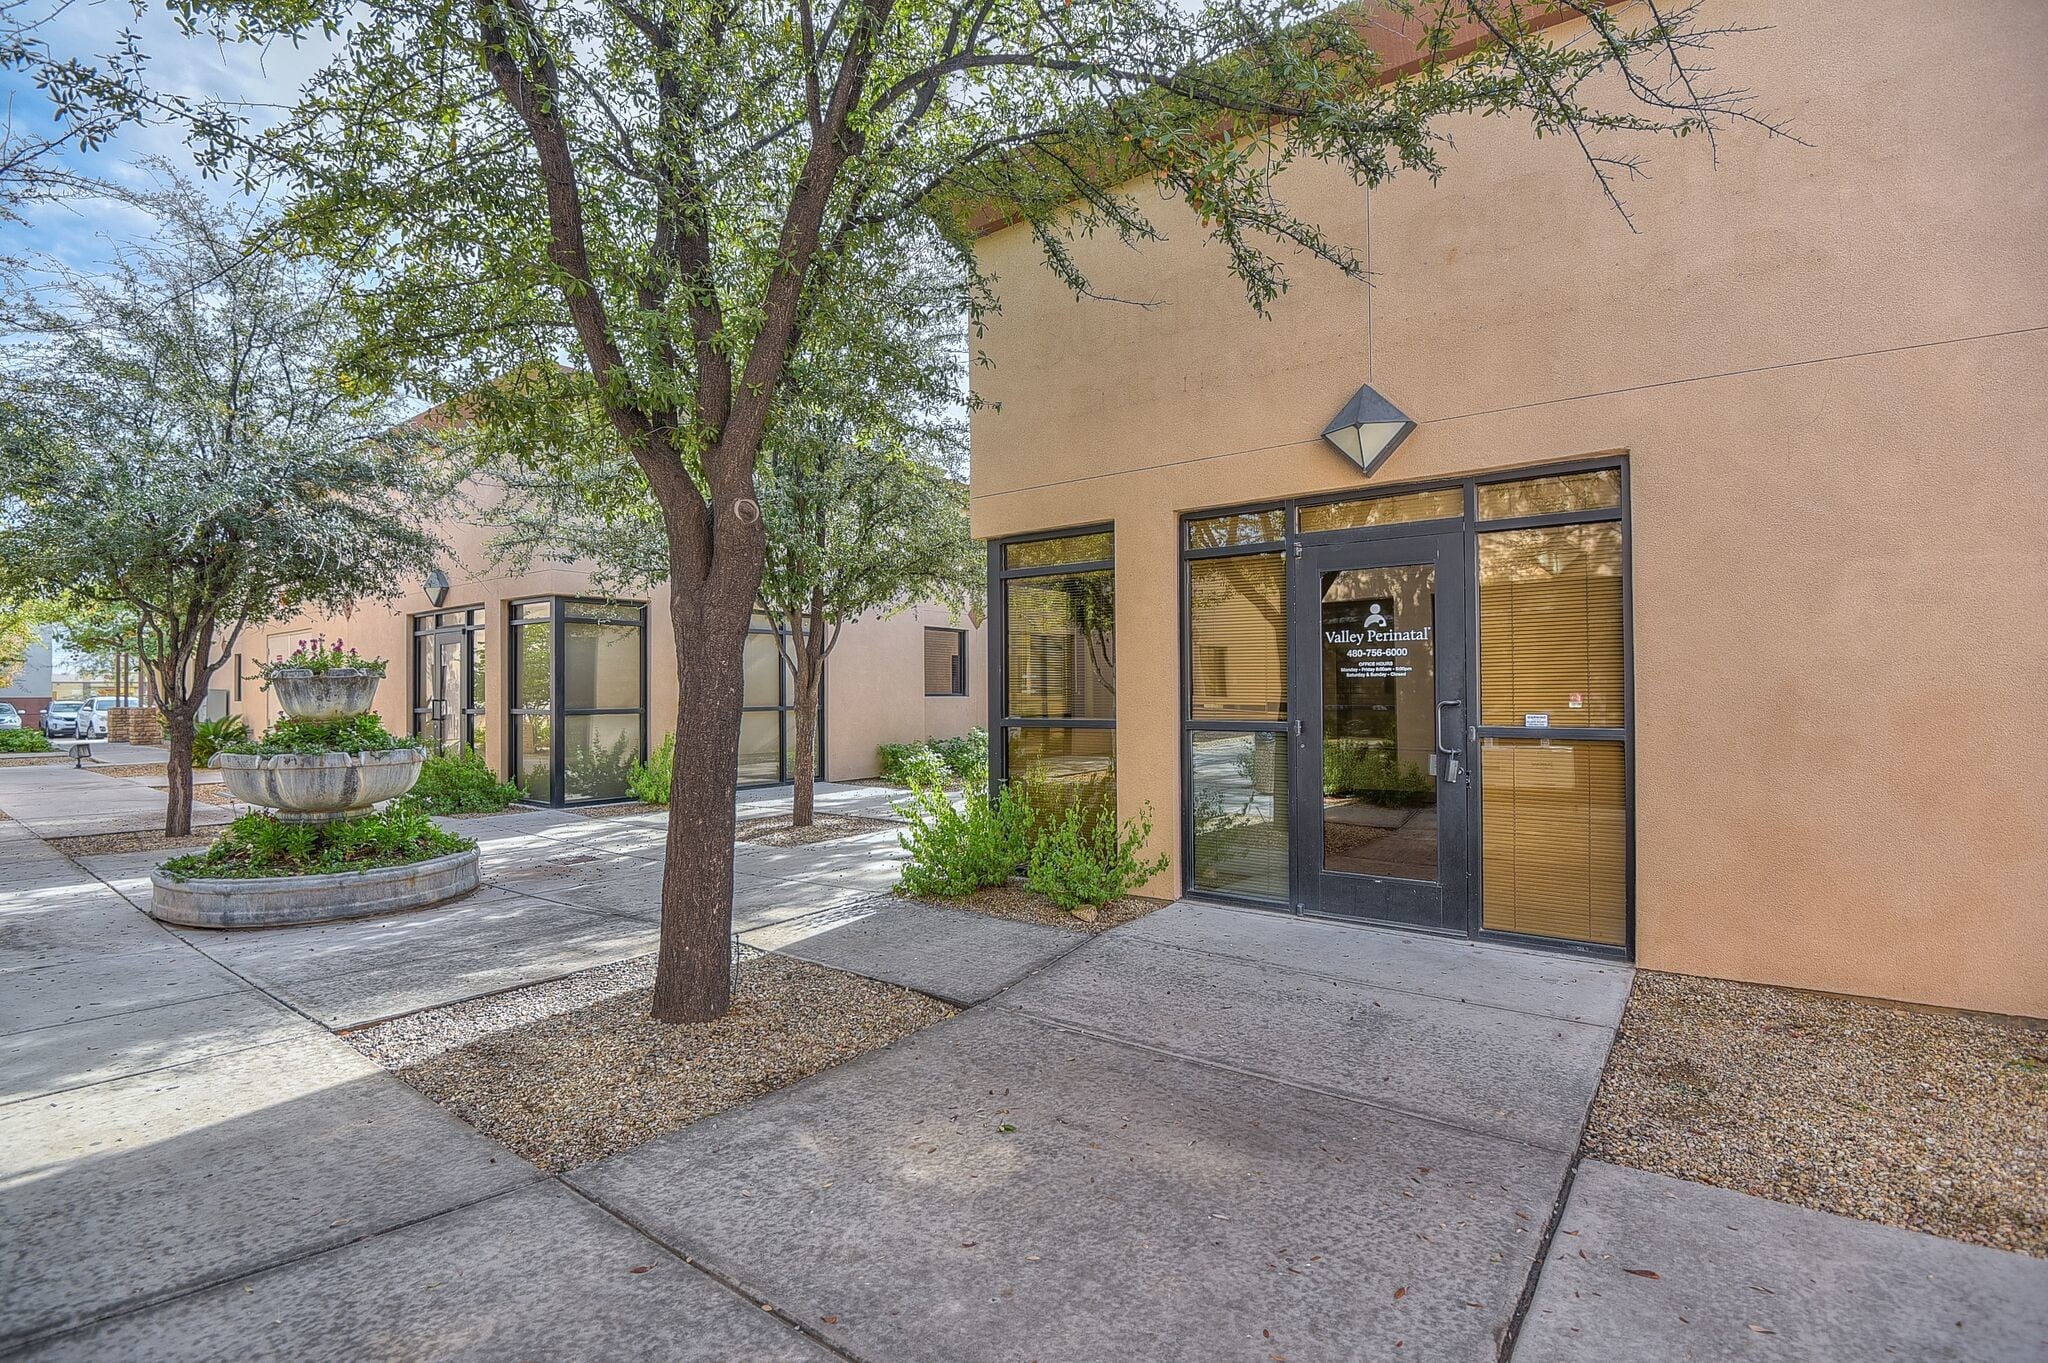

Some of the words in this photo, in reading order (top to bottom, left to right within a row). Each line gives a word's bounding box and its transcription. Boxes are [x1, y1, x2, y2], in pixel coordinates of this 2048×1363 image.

[1325, 630, 1364, 645] Valley
[1367, 627, 1429, 642] Perinatal
[1346, 648, 1408, 658] 480-756-6000
